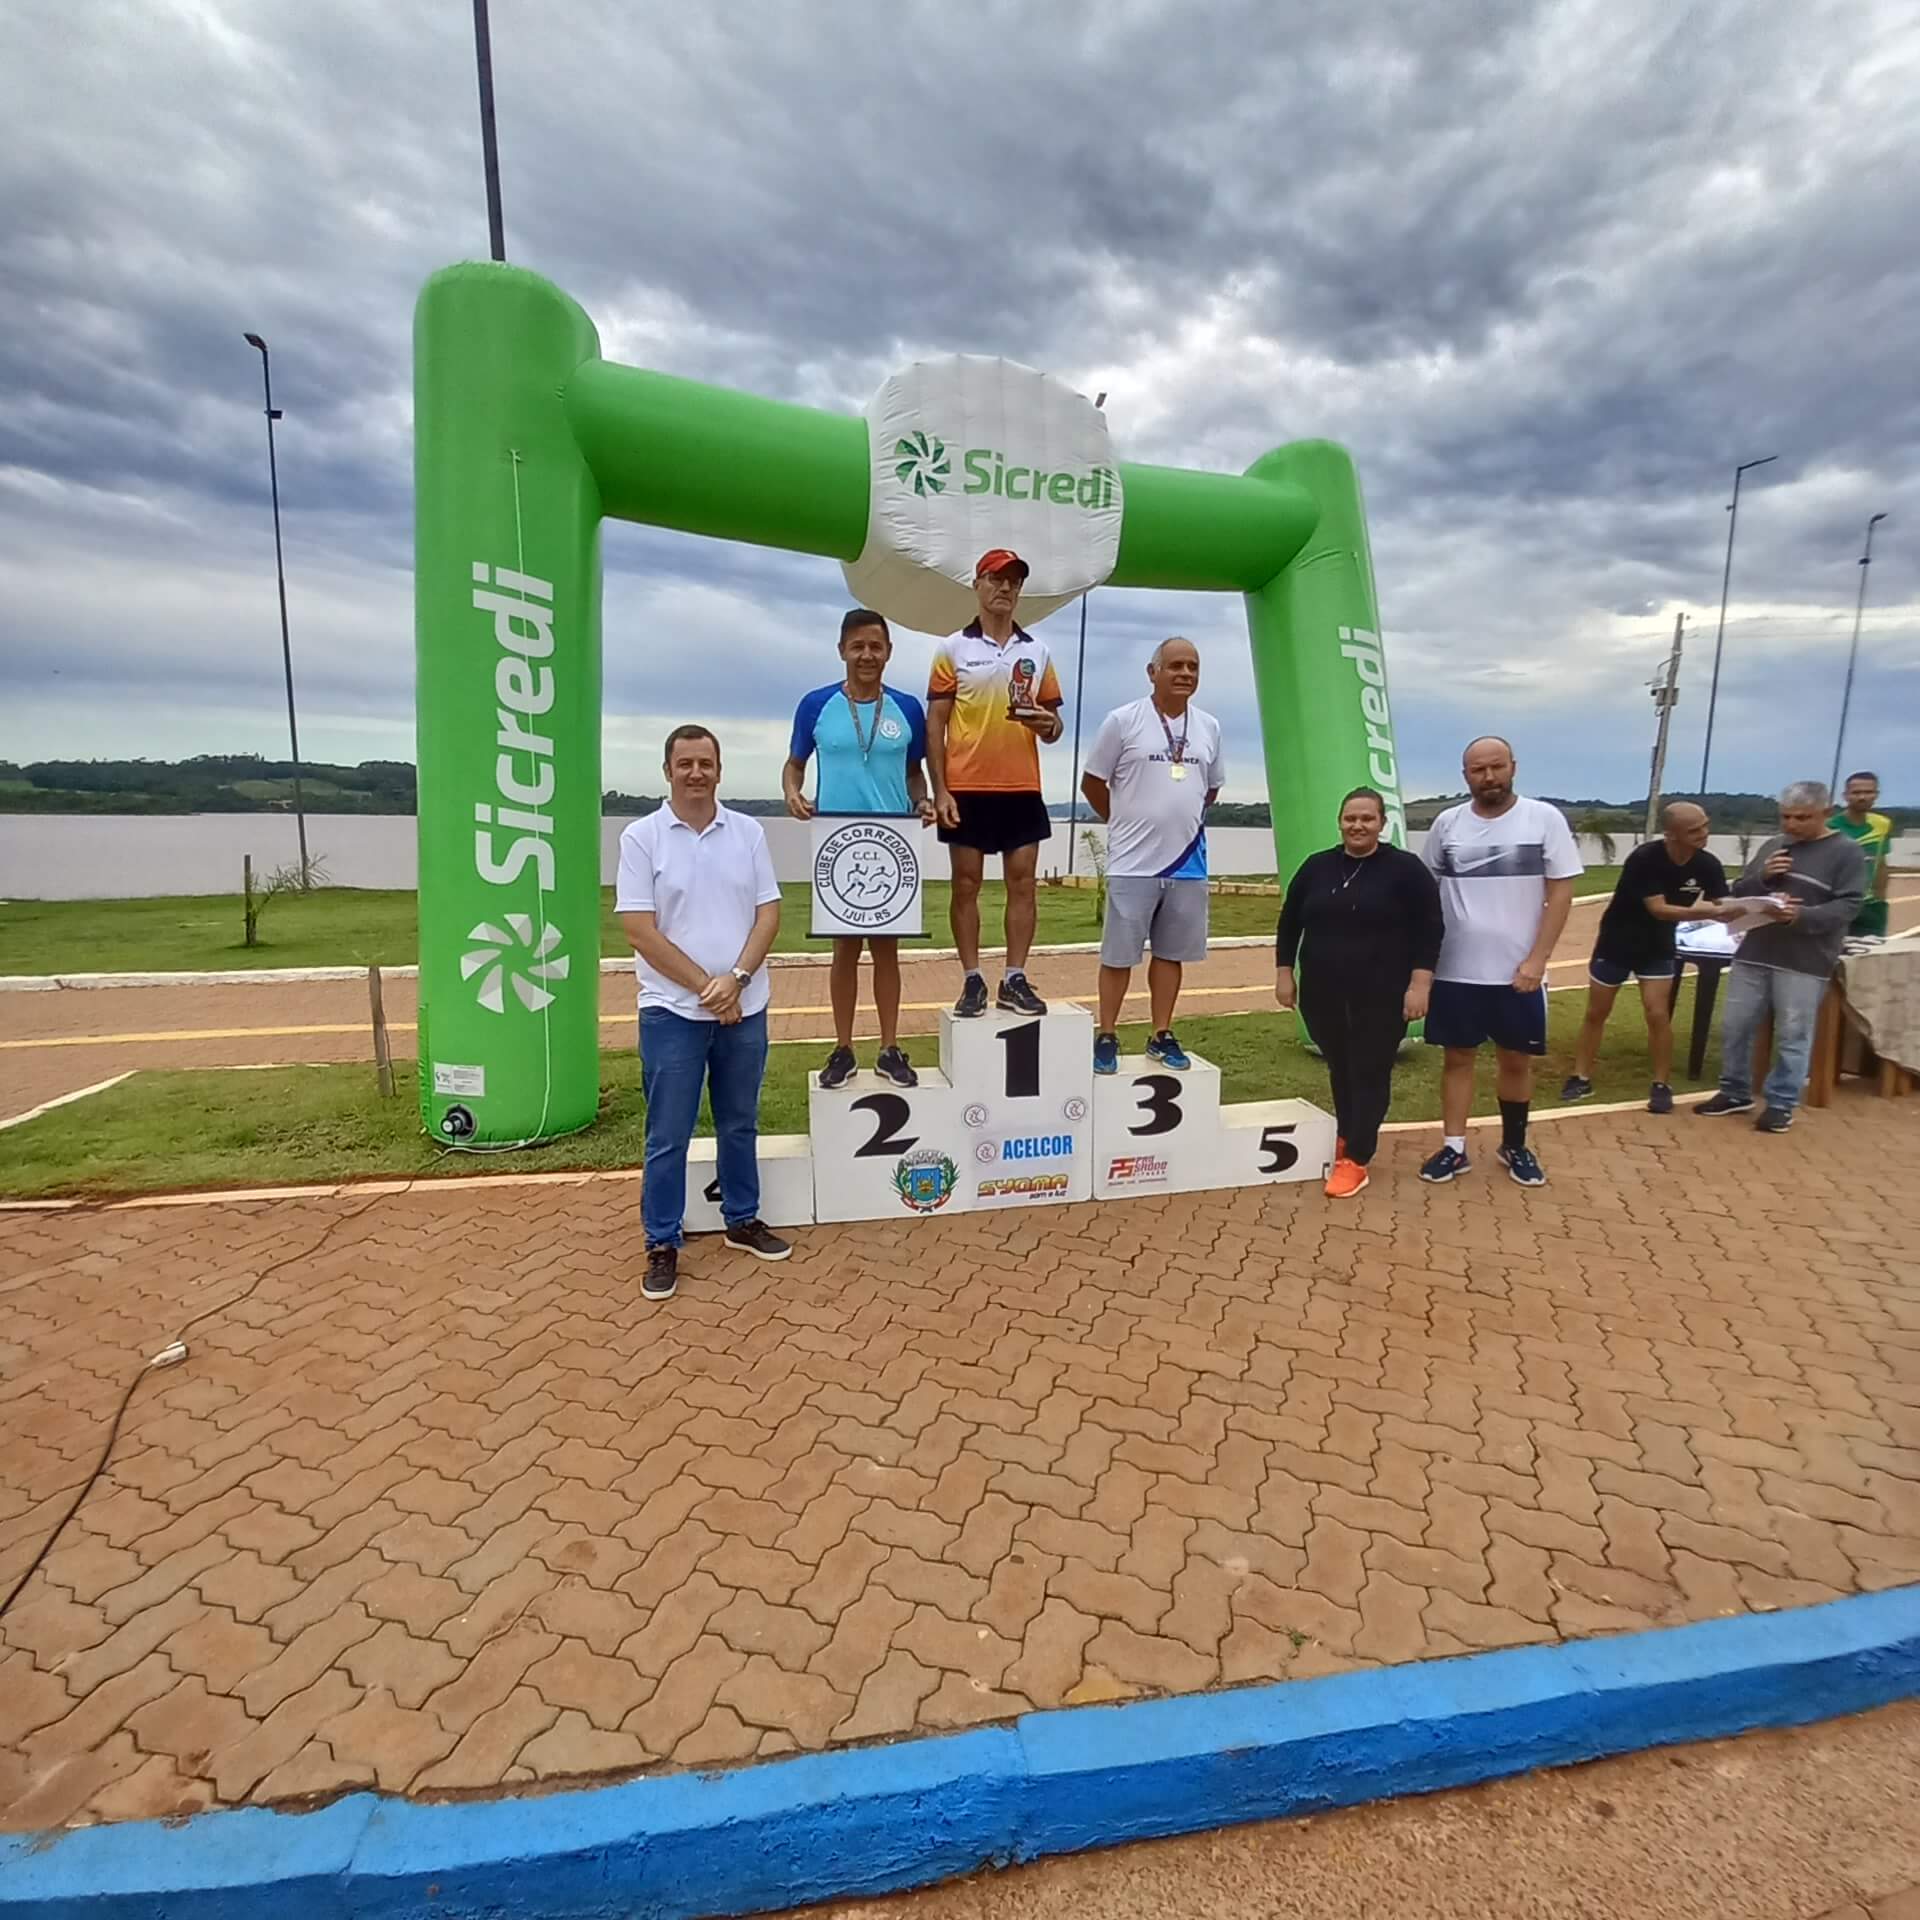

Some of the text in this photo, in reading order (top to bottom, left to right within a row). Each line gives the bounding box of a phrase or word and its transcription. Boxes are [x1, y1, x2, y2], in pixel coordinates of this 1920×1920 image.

[962, 448, 1113, 509] Sicredi
[472, 561, 556, 891] Sicredi
[818, 828, 915, 889] CLUBE DE CORREDORES DE
[852, 851, 881, 861] C.C.I.
[874, 908, 891, 921] RS
[996, 1020, 1041, 1098] 1
[851, 1093, 920, 1158] 2
[1128, 1074, 1183, 1136] 3
[1002, 1135, 1072, 1160] ACELCOR
[1258, 1125, 1299, 1174] 5
